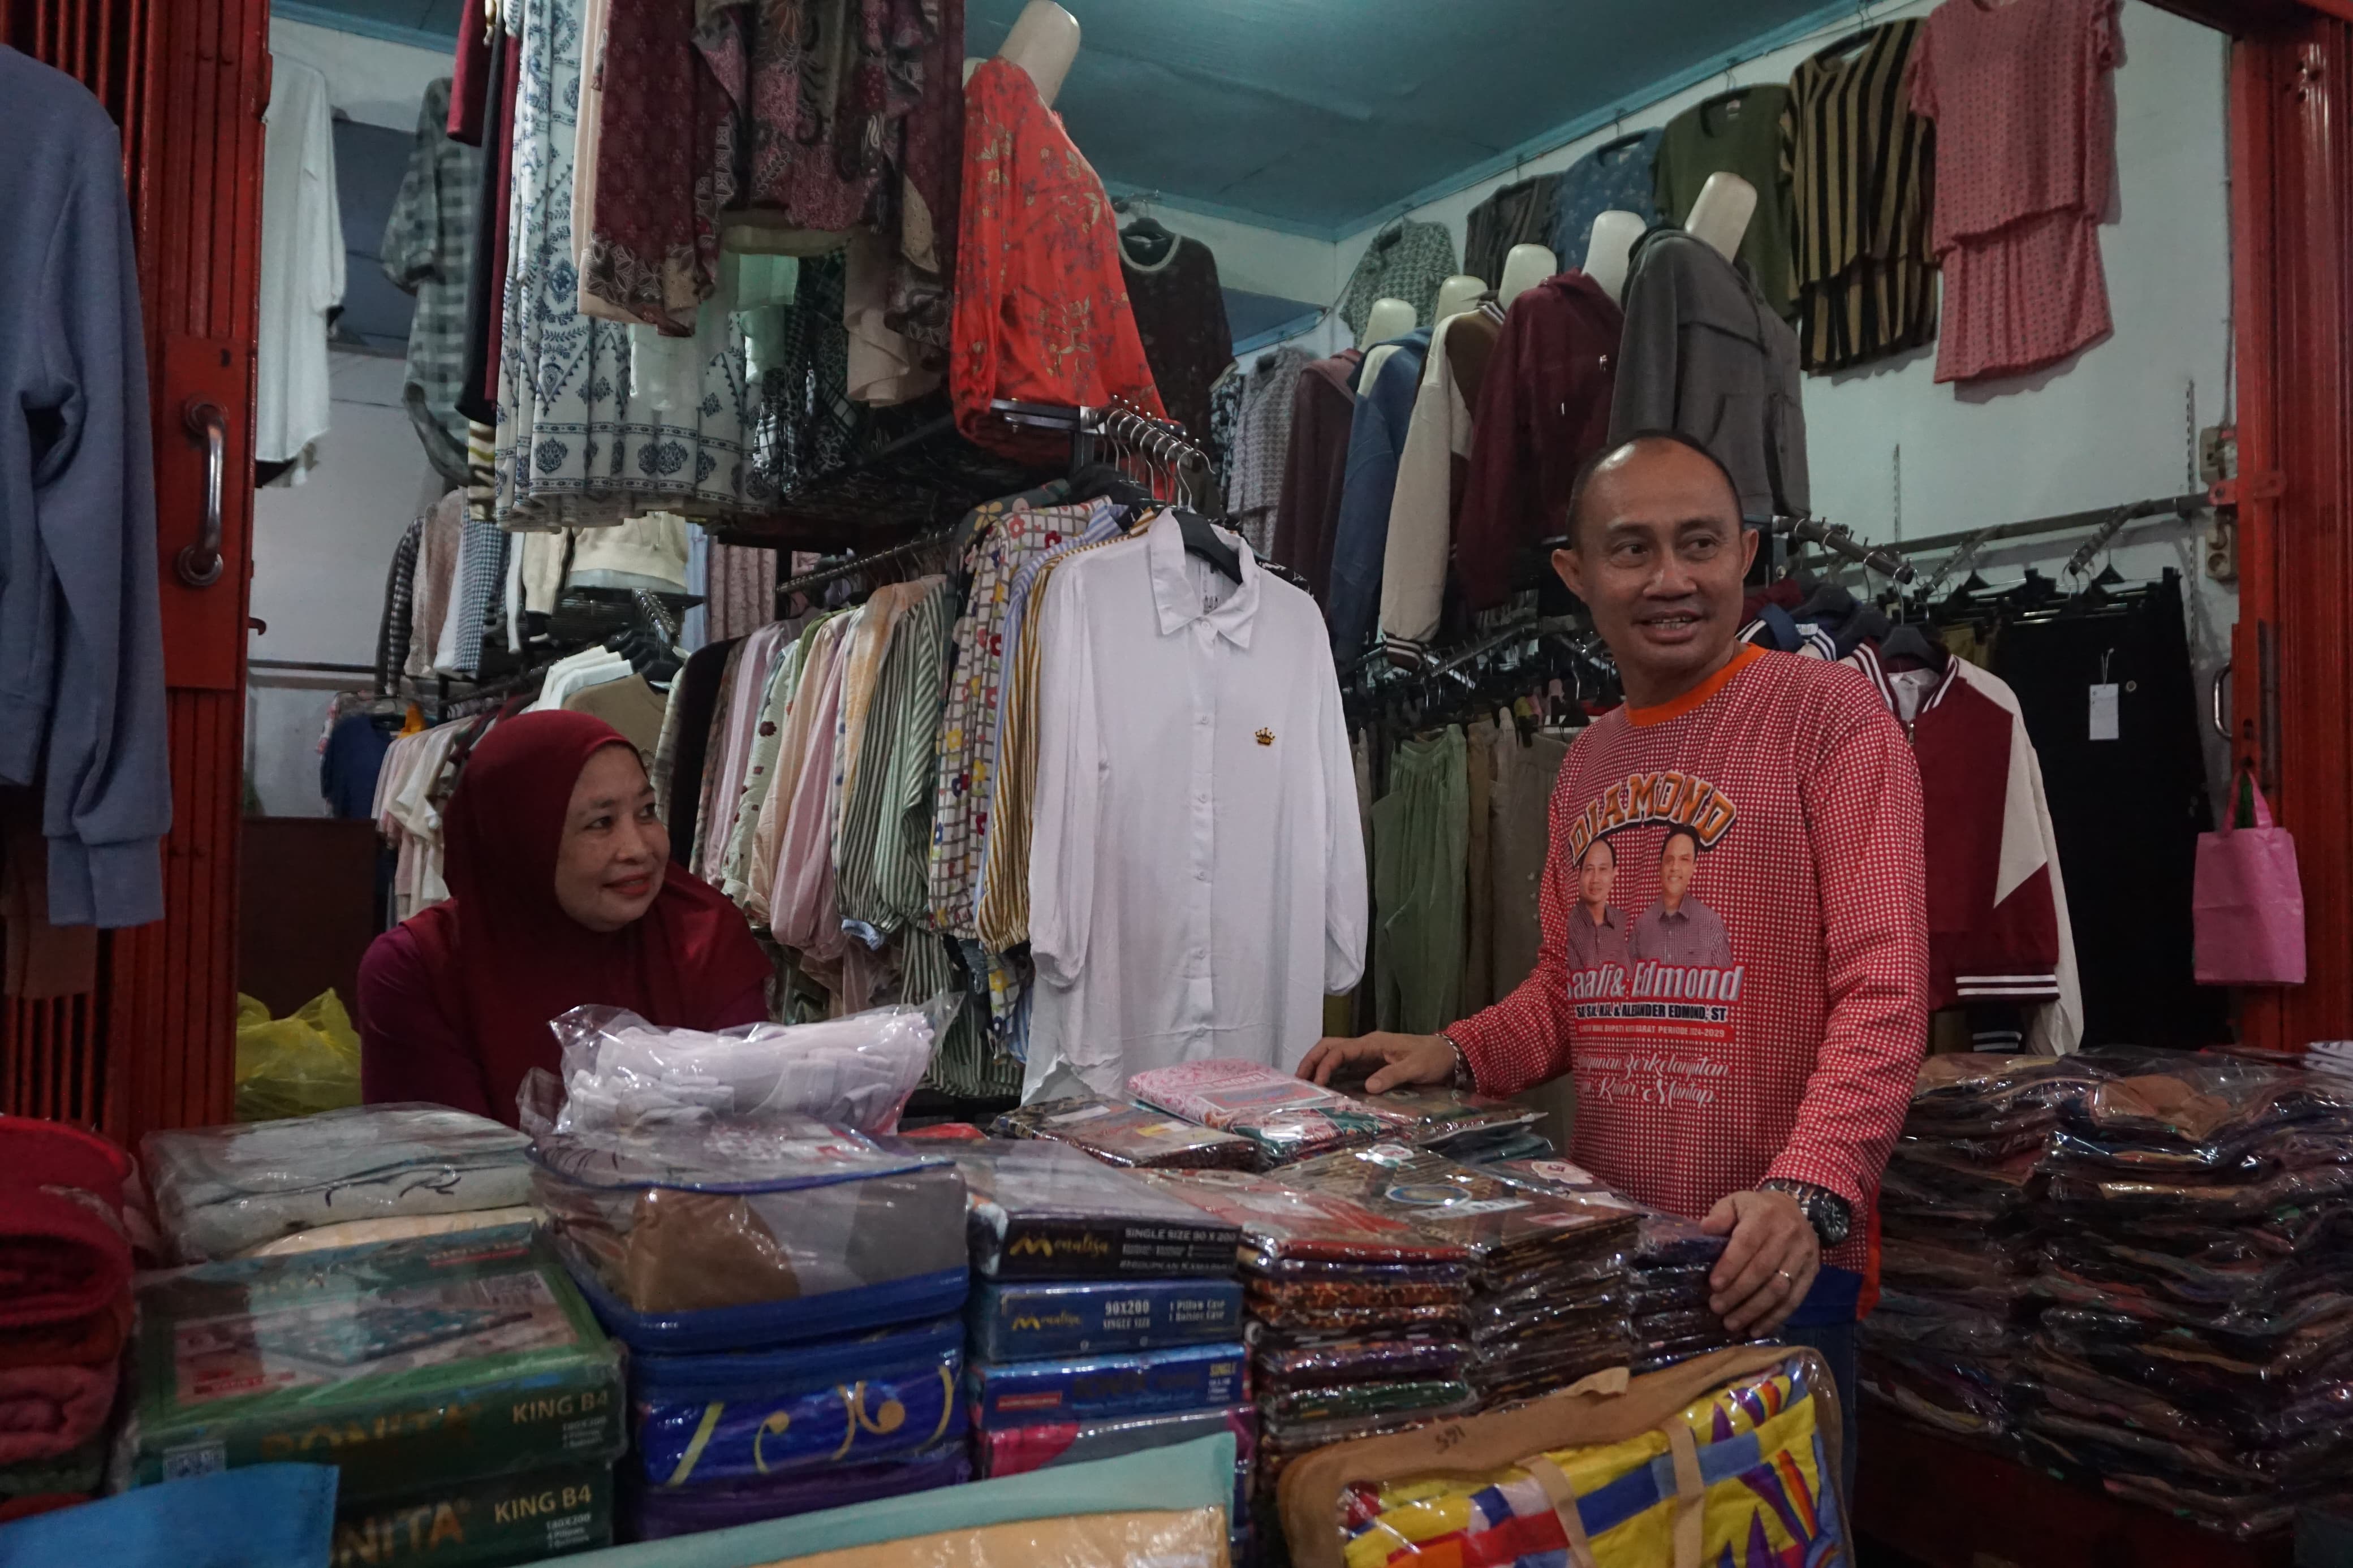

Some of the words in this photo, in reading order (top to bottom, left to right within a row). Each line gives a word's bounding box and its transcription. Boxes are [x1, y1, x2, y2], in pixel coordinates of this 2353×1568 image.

[1569, 770, 1736, 866] DIAMOND
[1631, 961, 1745, 1001] Edmond
[1658, 1026, 1688, 1035] PERIODE
[1711, 1007, 1726, 1021] ST
[1124, 1226, 1165, 1239] SINGLE
[1167, 1229, 1192, 1241] SIZE
[512, 1394, 574, 1424] KING
[580, 1389, 608, 1412] B4
[494, 1491, 557, 1524] KING
[562, 1483, 592, 1509] B4
